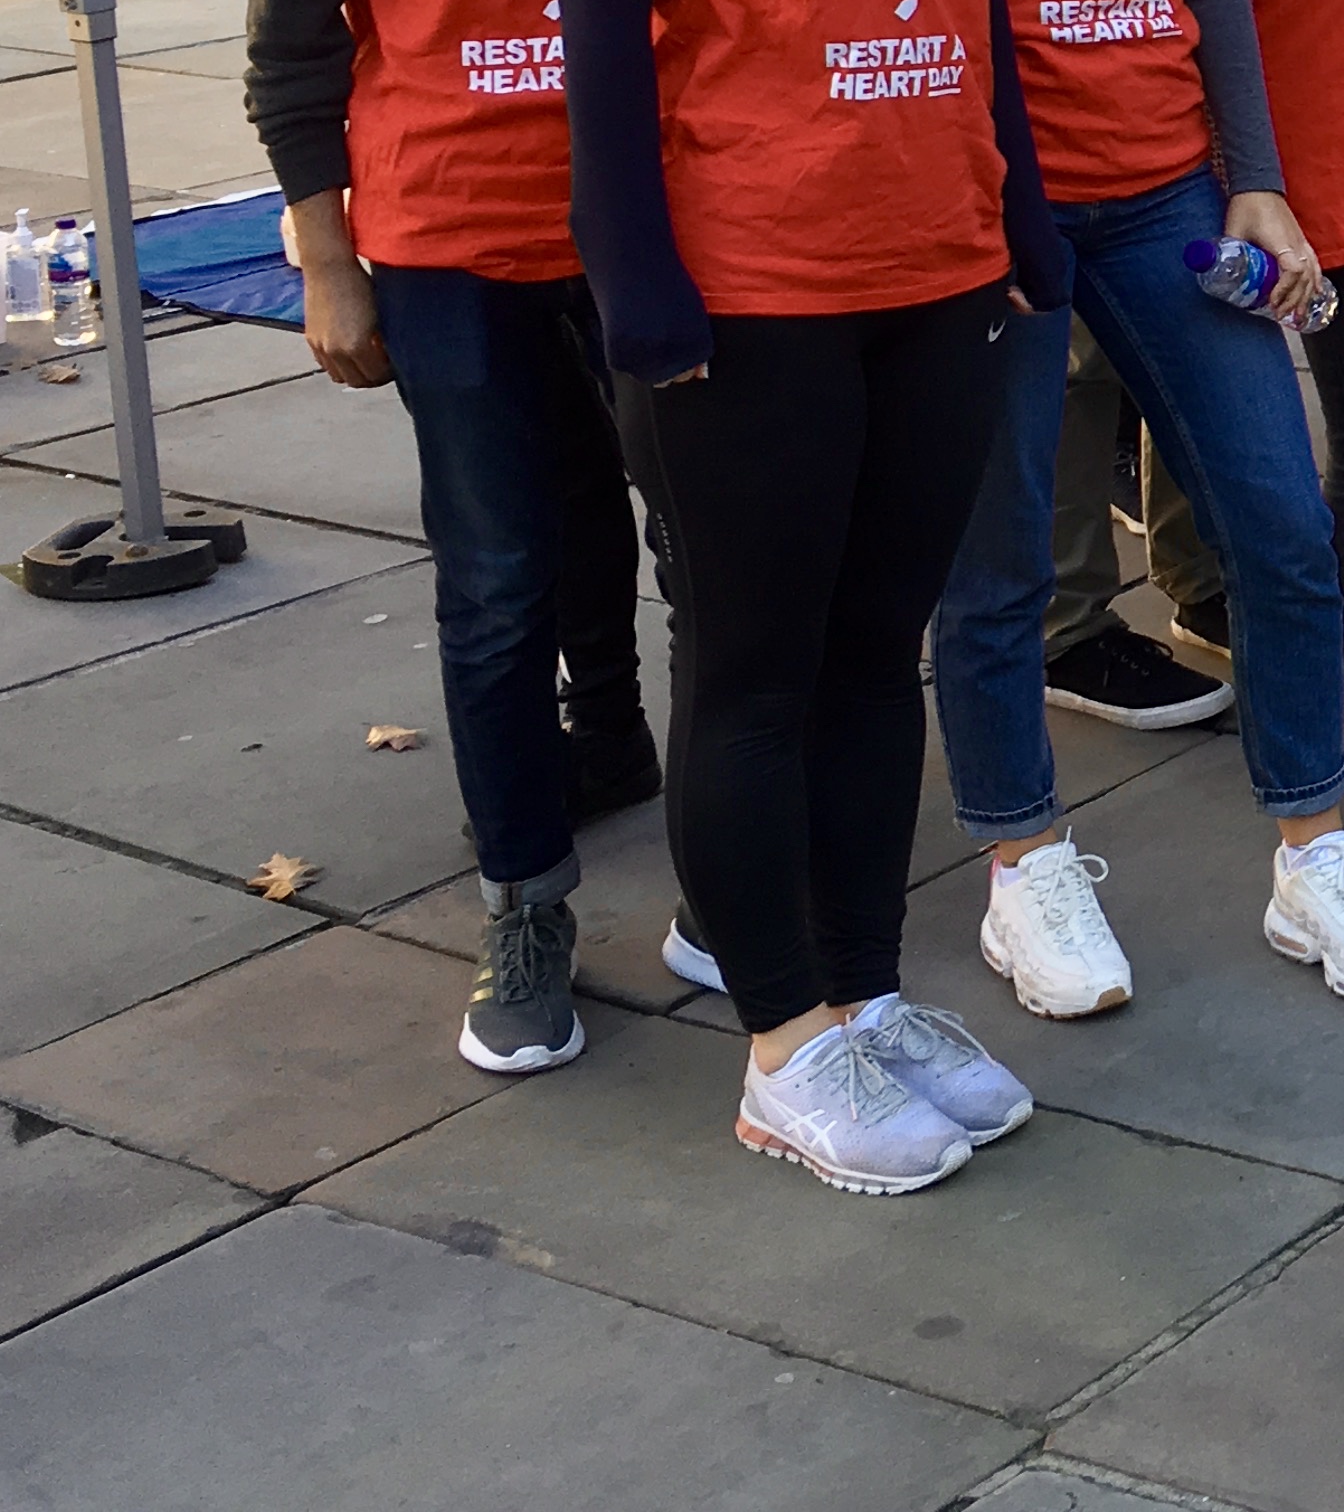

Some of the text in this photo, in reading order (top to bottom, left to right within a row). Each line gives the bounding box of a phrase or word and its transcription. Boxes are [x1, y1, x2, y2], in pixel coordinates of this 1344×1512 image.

[1049, 14, 1180, 44] HEART DA
[825, 34, 967, 68] RESTART A
[829, 65, 964, 101] HEART DAY
